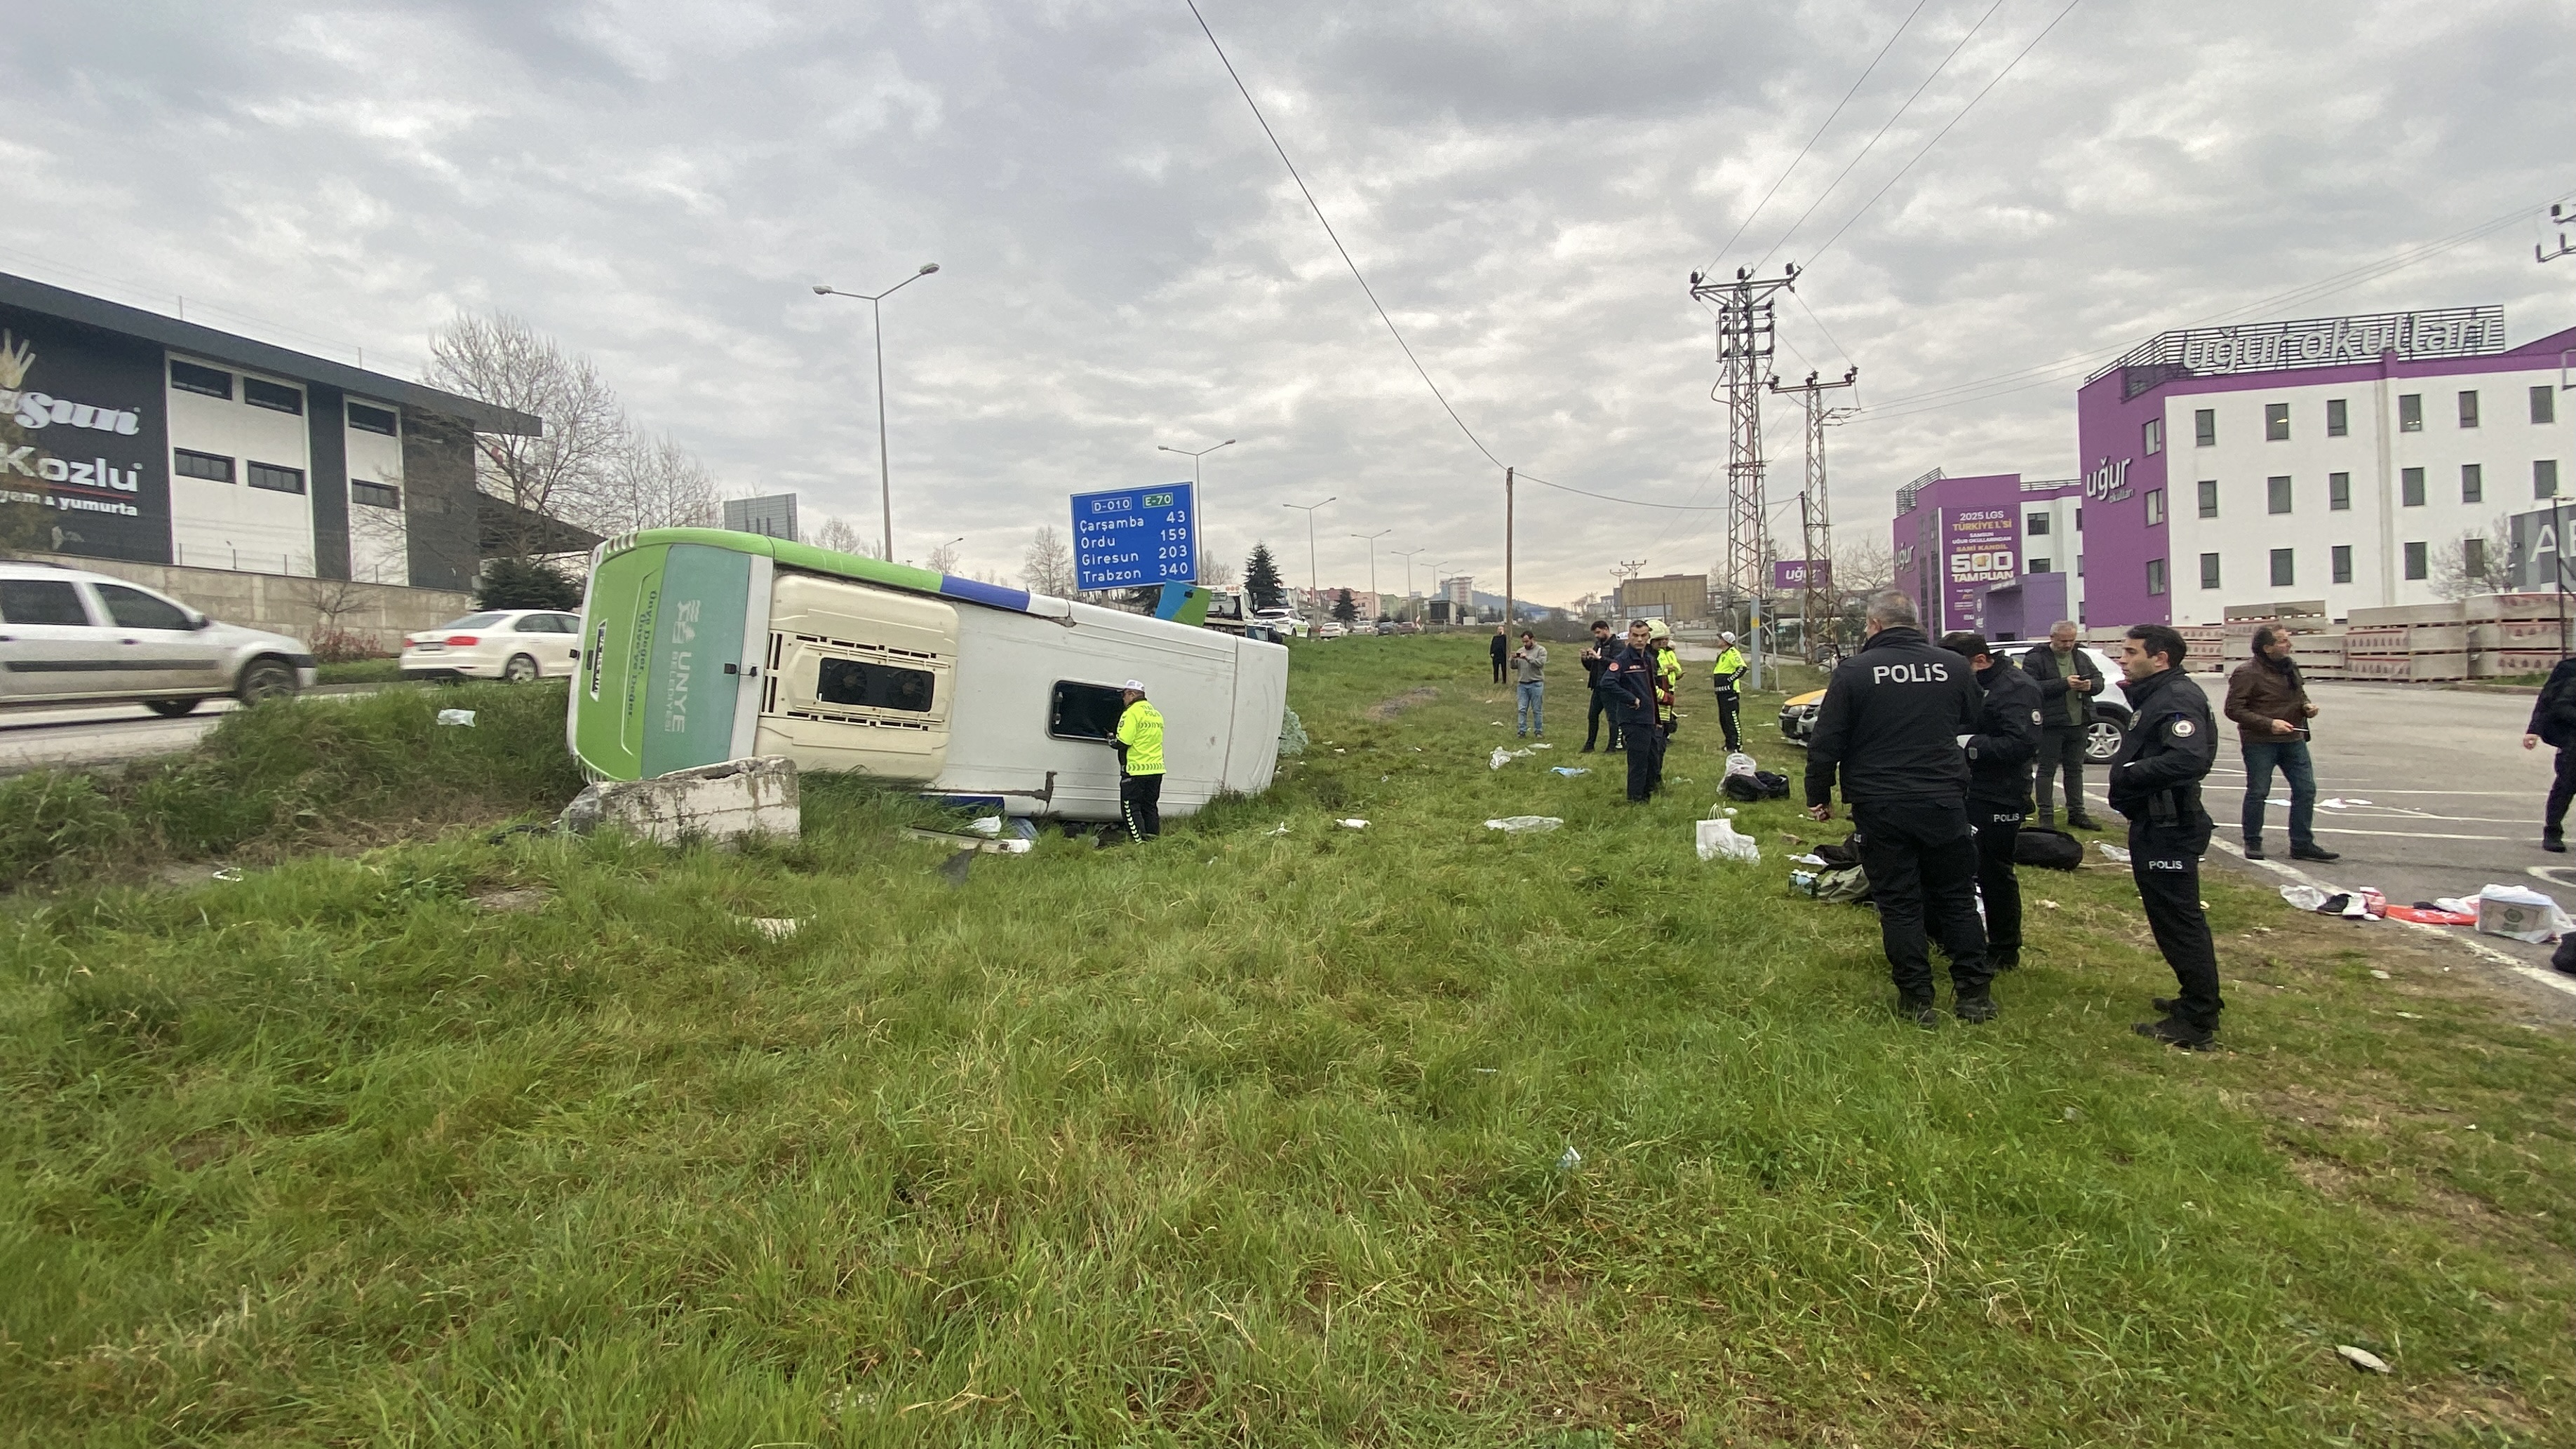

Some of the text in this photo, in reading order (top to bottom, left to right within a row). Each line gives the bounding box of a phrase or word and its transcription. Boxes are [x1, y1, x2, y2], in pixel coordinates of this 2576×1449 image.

[2182, 314, 2493, 375] uğur okulları
[0, 443, 138, 492] Kozlu
[2086, 456, 2132, 501] uğur
[58, 497, 138, 516] yumurta
[1094, 499, 1130, 511] D-010
[1145, 494, 1172, 506] E-70
[1080, 511, 1186, 534] Çarşamba 43
[1959, 511, 2004, 521] 2025 LGS
[1081, 527, 1186, 549] Ordu 159
[1082, 545, 1188, 566] Giresun 203
[1951, 551, 2013, 573] 500
[1083, 562, 1188, 583] Trabzon 340
[1951, 571, 2013, 583] TAM PUAN
